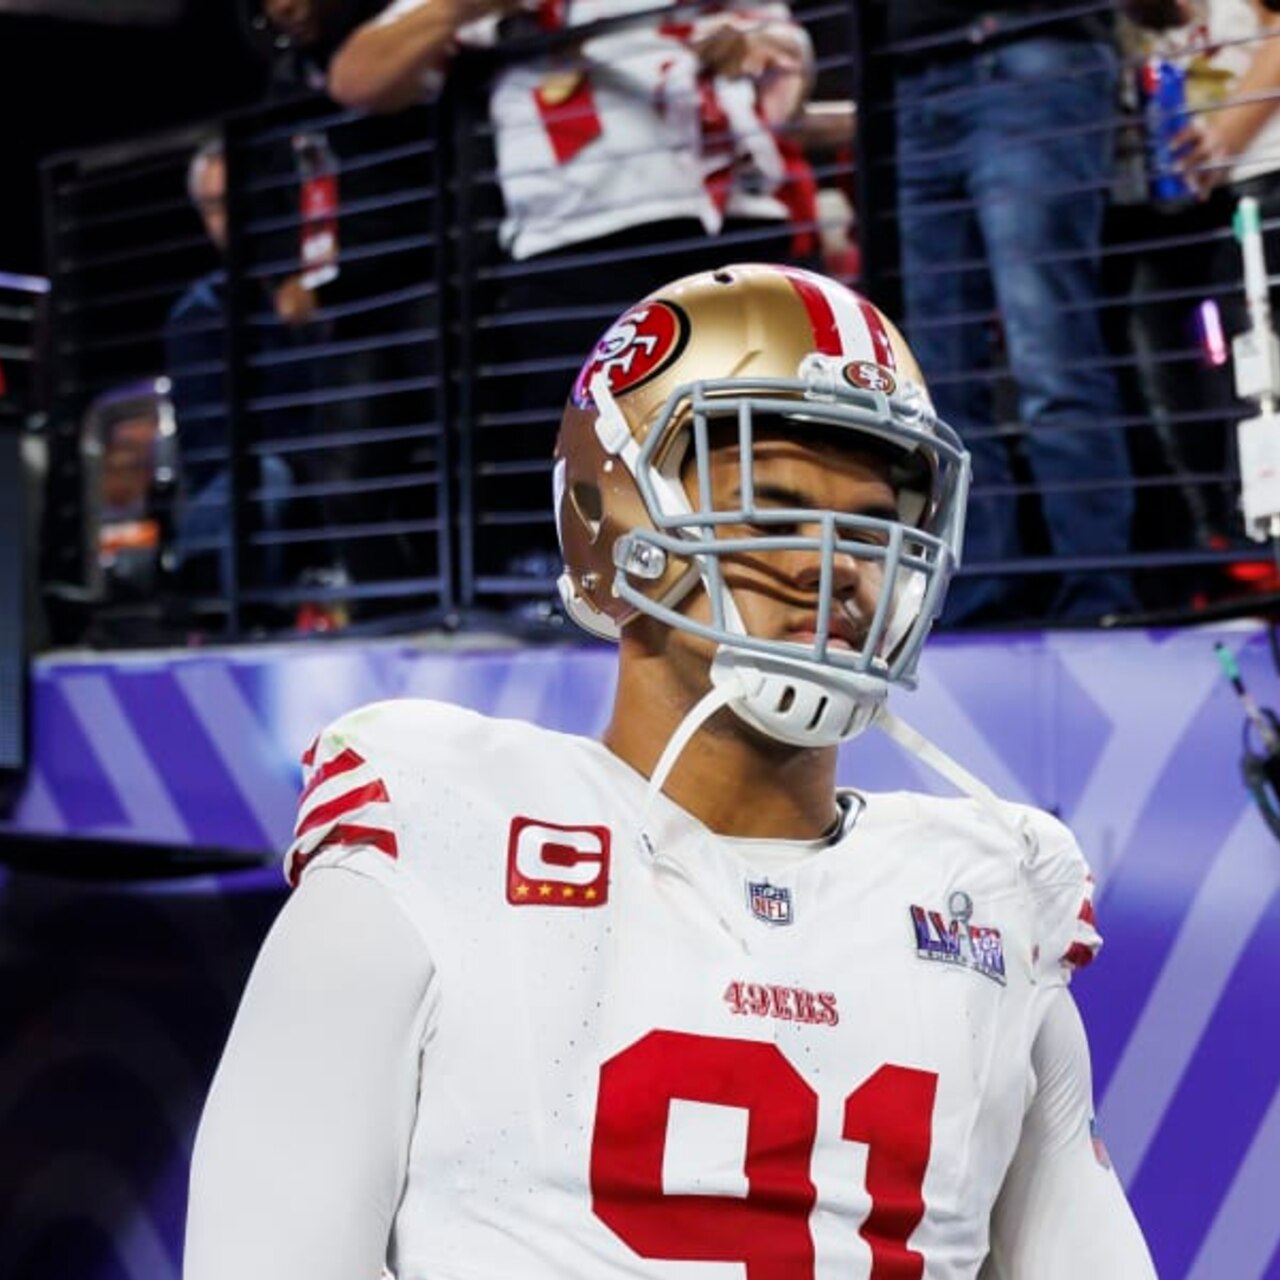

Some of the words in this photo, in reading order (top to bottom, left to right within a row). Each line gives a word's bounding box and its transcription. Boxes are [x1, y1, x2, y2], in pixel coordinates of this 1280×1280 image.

[516, 825, 602, 885] C
[754, 897, 787, 918] NFL
[724, 979, 840, 1027] 49ERS
